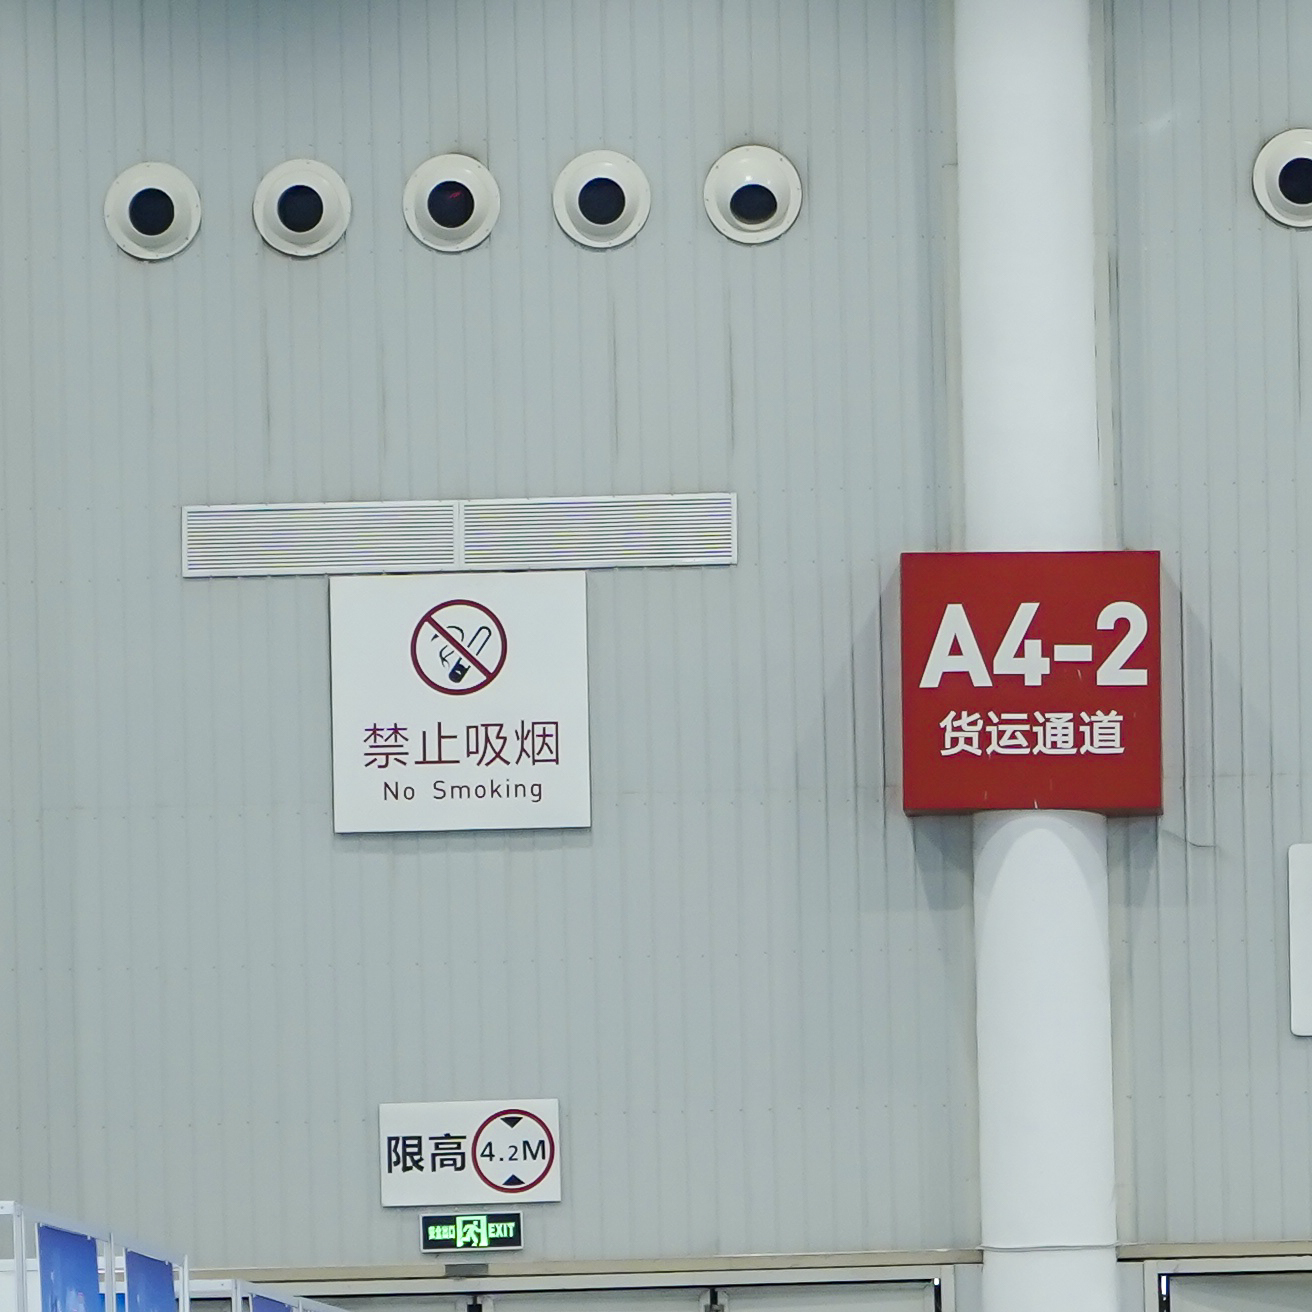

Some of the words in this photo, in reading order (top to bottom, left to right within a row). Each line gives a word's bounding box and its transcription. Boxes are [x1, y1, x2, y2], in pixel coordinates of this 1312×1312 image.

[919, 600, 1149, 690] A4-2
[362, 721, 561, 771] 禁止吸烟
[939, 710, 1126, 759] 货运通道
[383, 782, 416, 802] No
[432, 778, 544, 804] Smoking
[386, 1133, 467, 1174] 限高
[479, 1139, 546, 1162] 4.2M
[487, 1221, 516, 1238] EXIT
